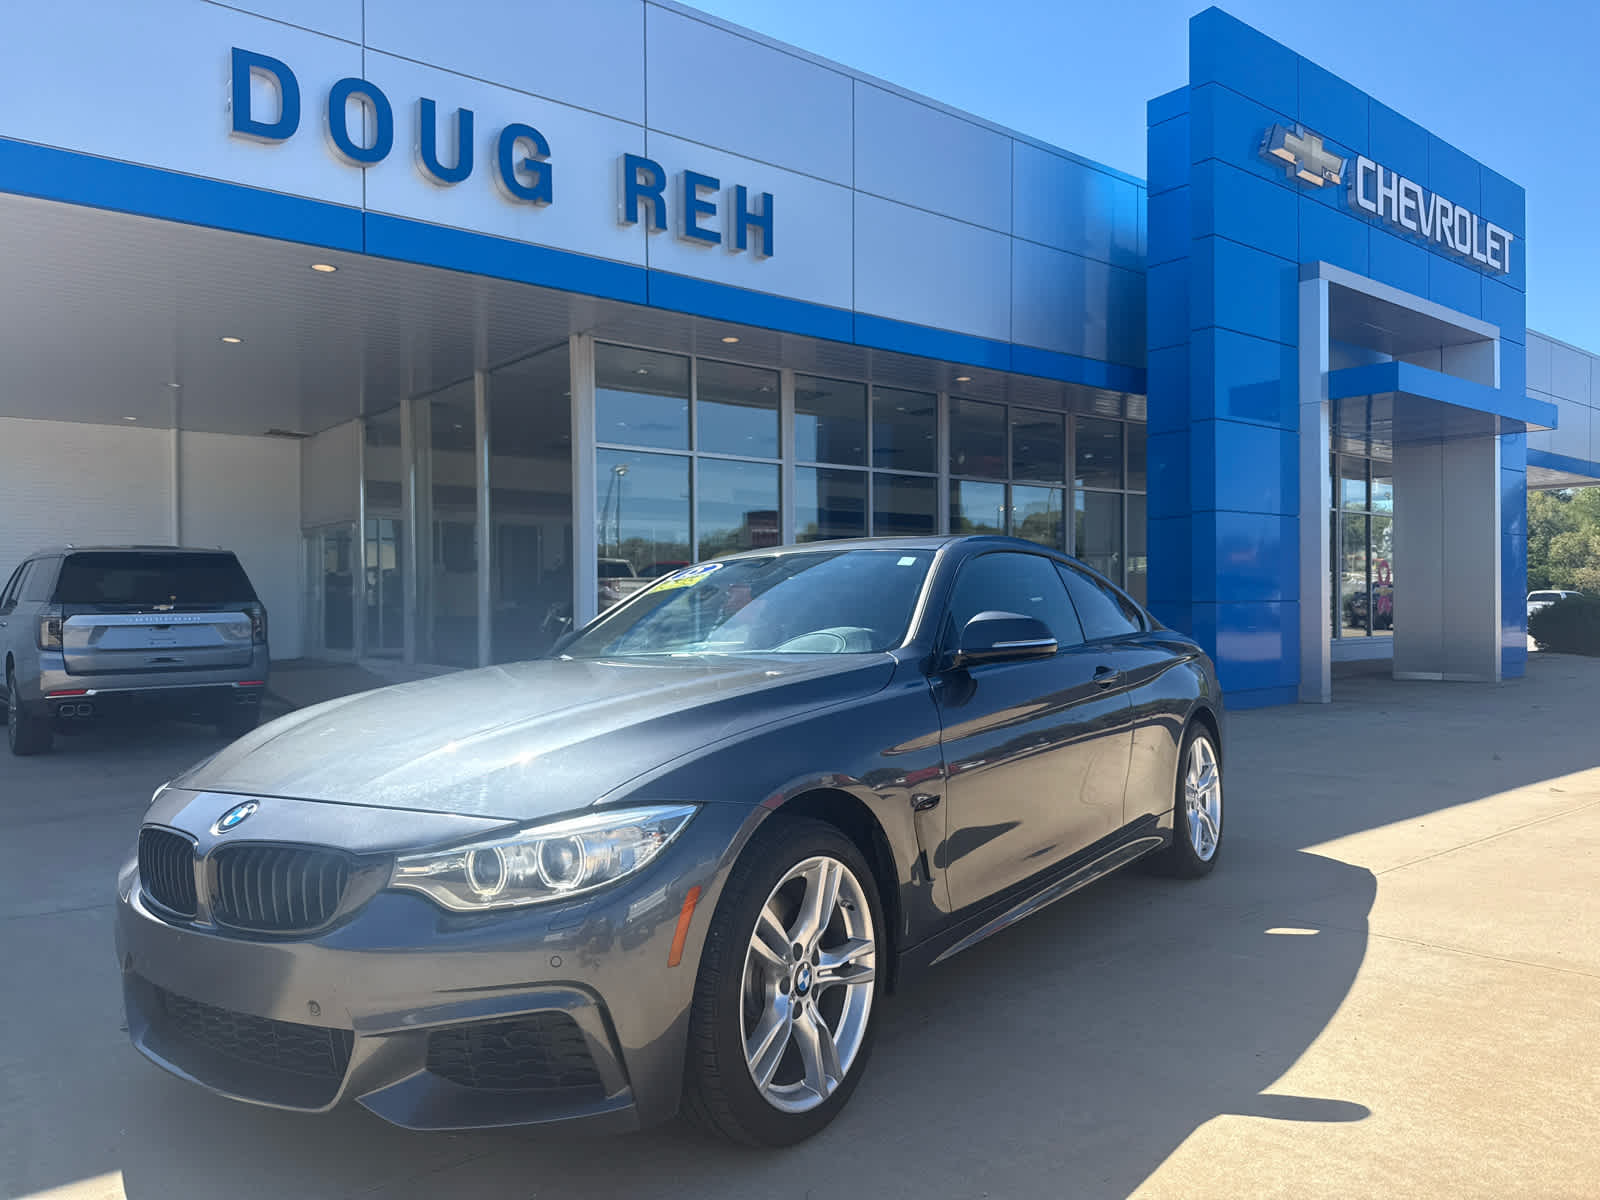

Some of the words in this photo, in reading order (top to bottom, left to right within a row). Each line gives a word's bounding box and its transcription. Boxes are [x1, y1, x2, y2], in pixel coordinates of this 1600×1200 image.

[230, 46, 553, 206] DOUG
[620, 152, 774, 258] REH
[1355, 154, 1514, 274] CHEVROLET
